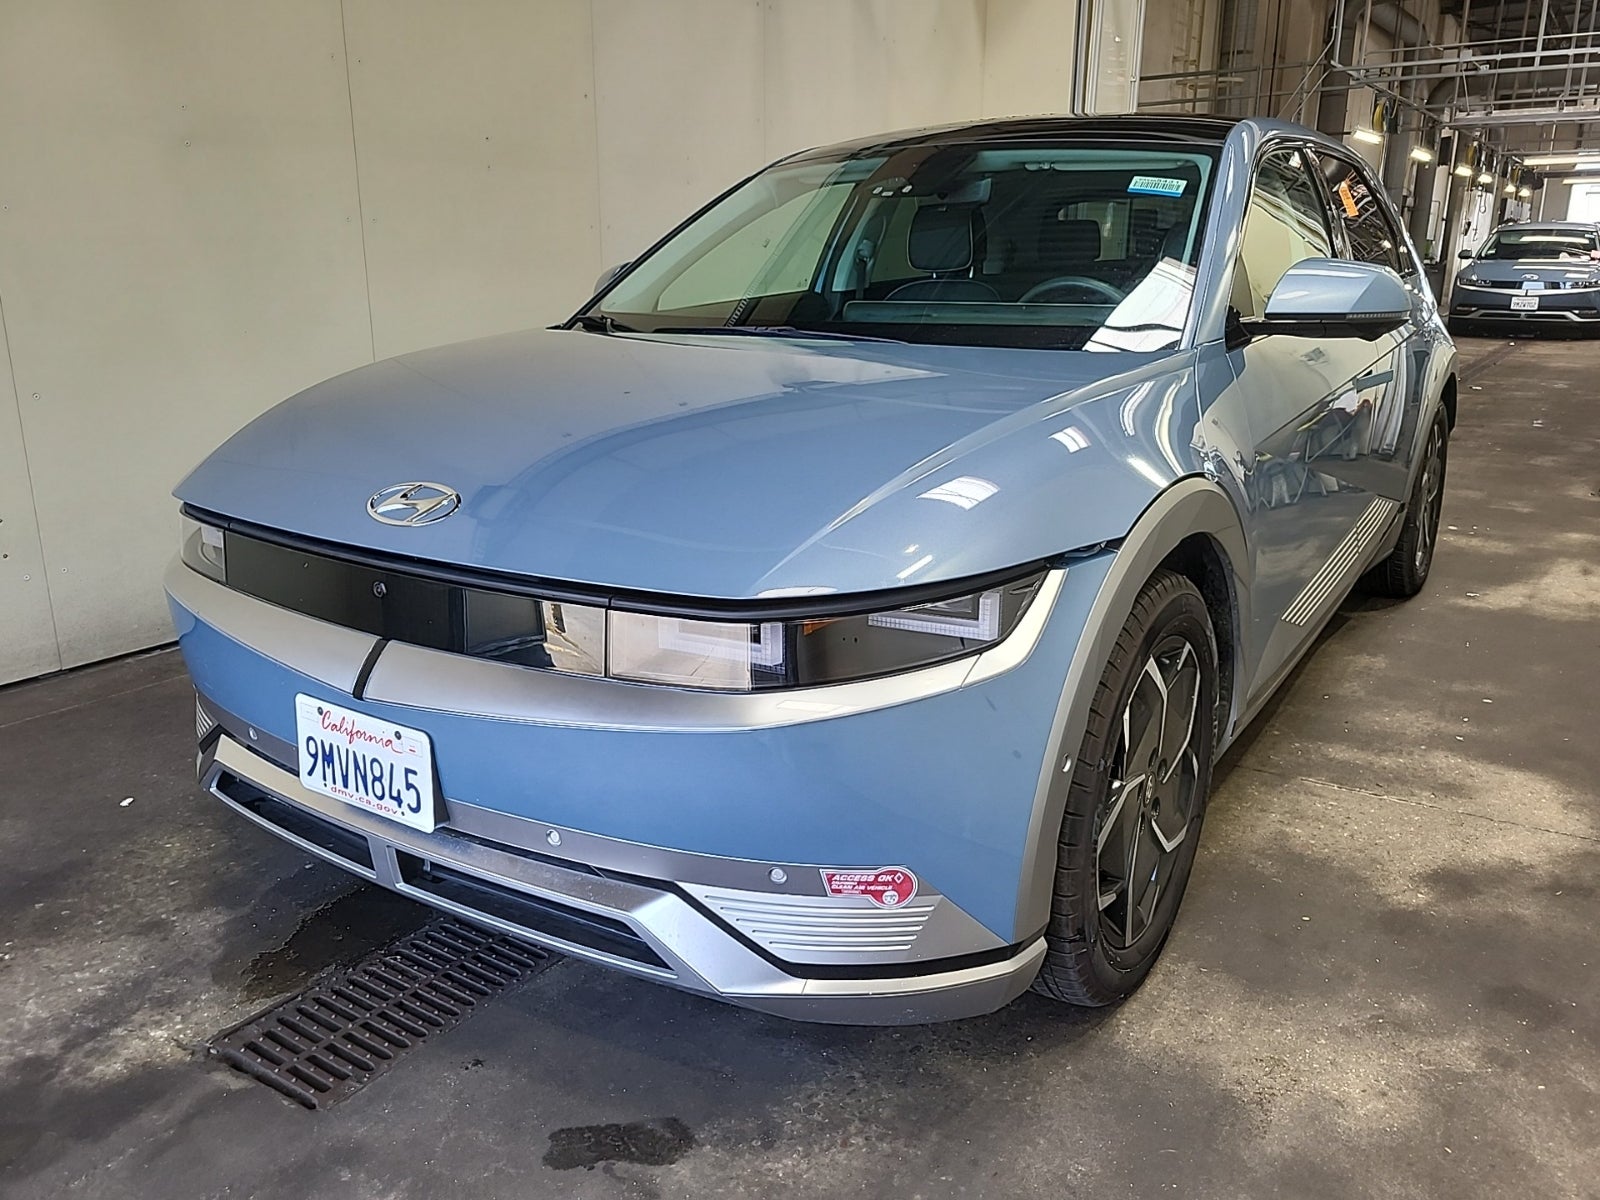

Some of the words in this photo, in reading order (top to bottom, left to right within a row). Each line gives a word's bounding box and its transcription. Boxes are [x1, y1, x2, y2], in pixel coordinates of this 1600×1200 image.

[321, 710, 403, 754] California
[306, 735, 421, 814] 9MVN845
[331, 786, 398, 815] dmv.ca.gov
[832, 874, 875, 882] ACCESS
